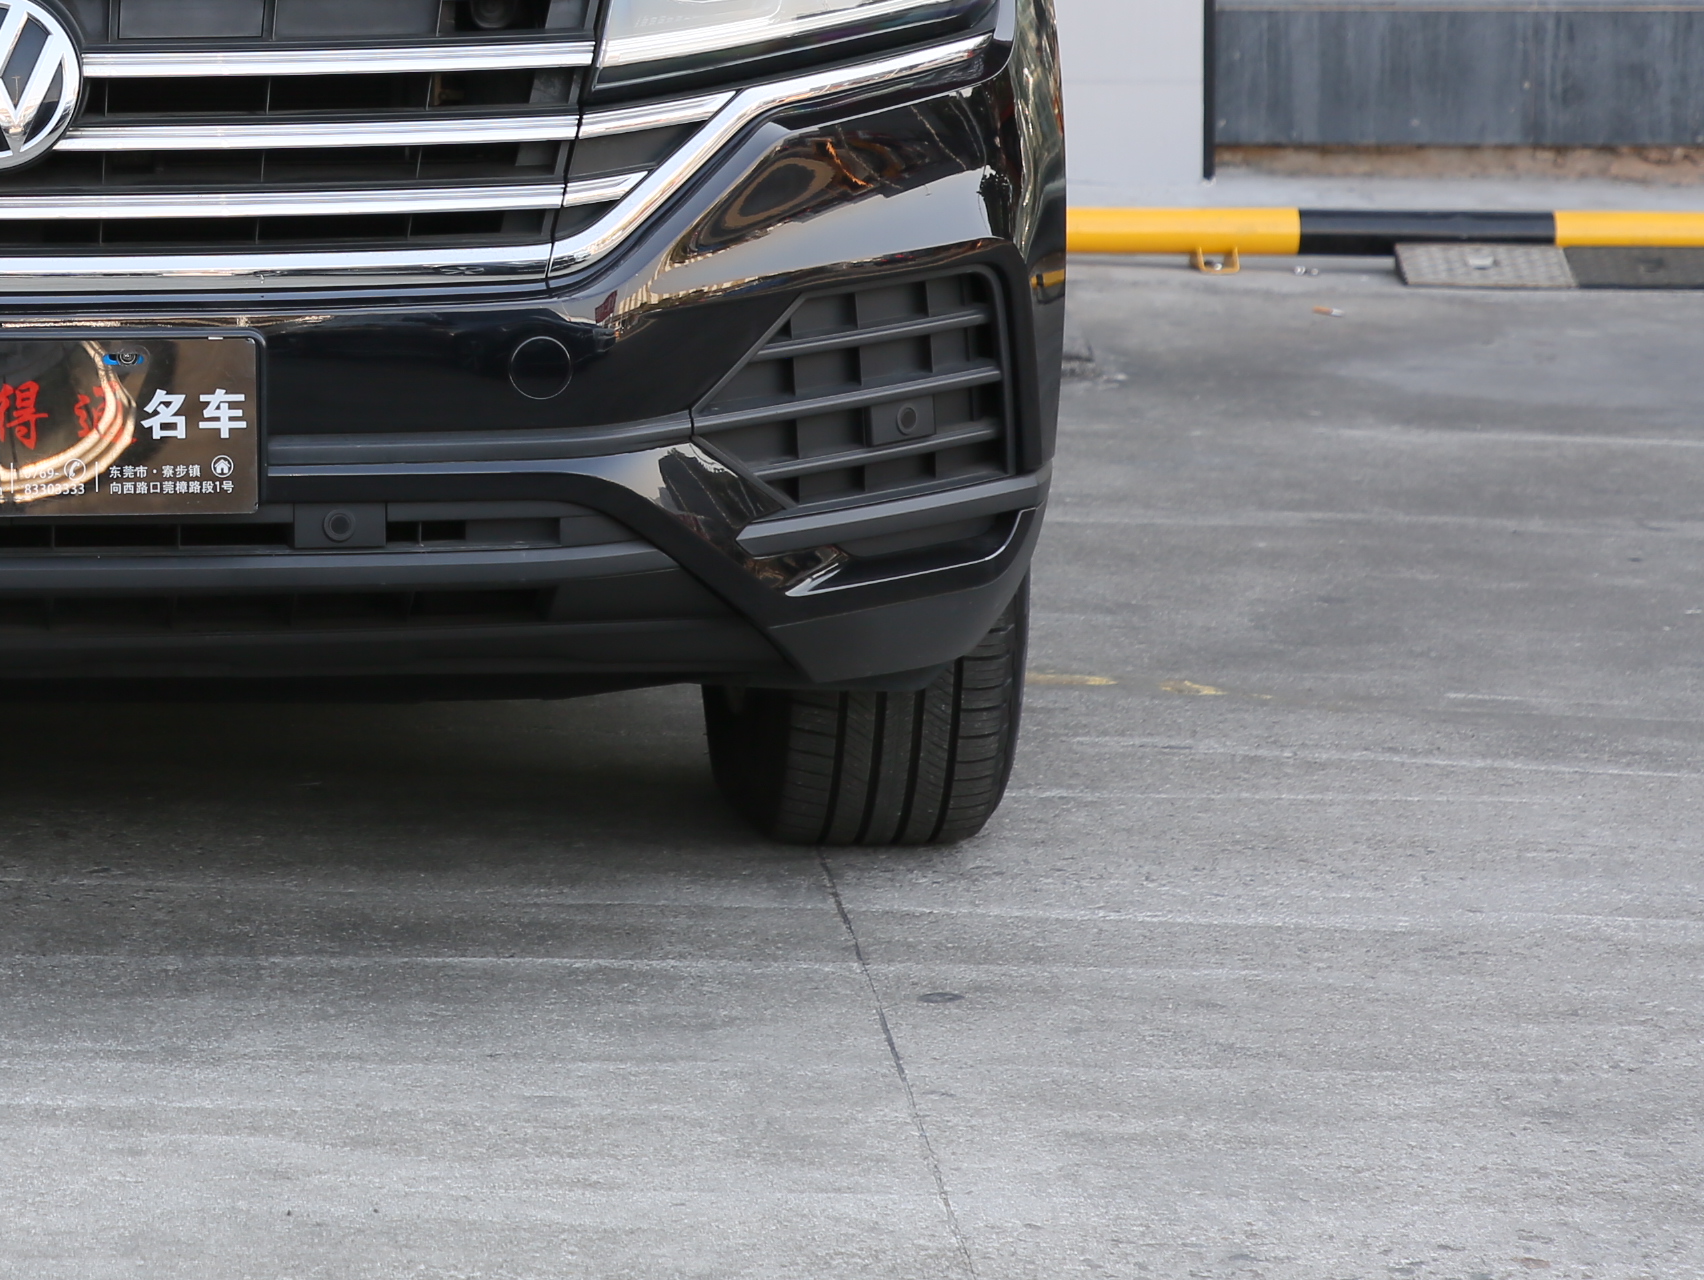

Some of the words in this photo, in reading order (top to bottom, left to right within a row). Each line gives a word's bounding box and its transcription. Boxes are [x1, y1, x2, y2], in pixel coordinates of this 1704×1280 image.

[109, 480, 234, 495] 向西路口莞樟路段1号
